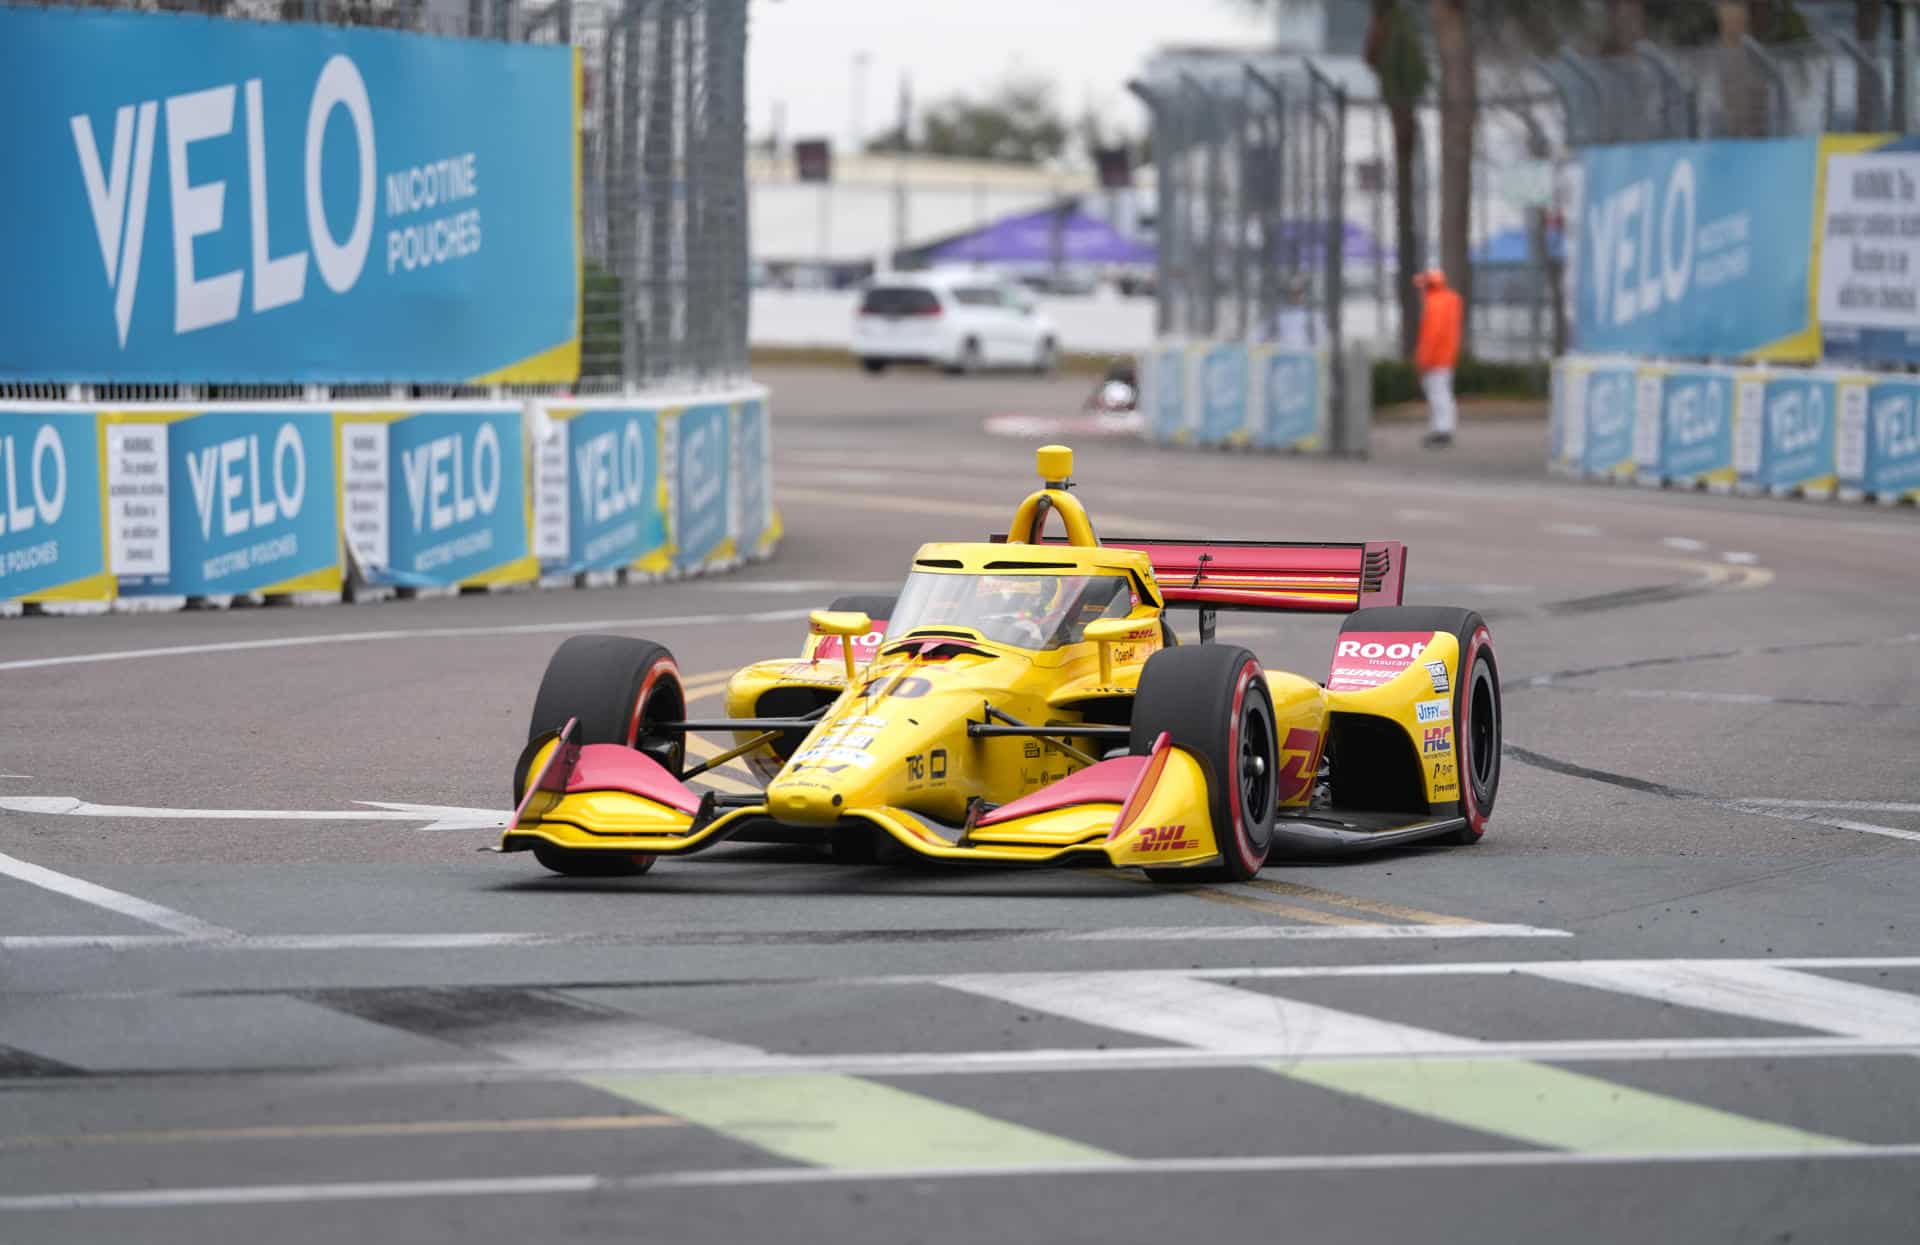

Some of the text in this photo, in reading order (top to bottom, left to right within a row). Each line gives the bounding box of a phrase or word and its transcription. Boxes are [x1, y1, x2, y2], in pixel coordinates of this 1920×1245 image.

[70, 54, 376, 350] VELO
[386, 153, 477, 217] NICOTINE
[388, 210, 481, 274] POUCHES
[1589, 158, 1694, 326] VELO
[186, 422, 305, 542] VELO
[403, 421, 500, 533] VELO
[575, 418, 644, 526] VELO
[1424, 726, 1452, 753] HRC
[1132, 825, 1201, 853] DHL
